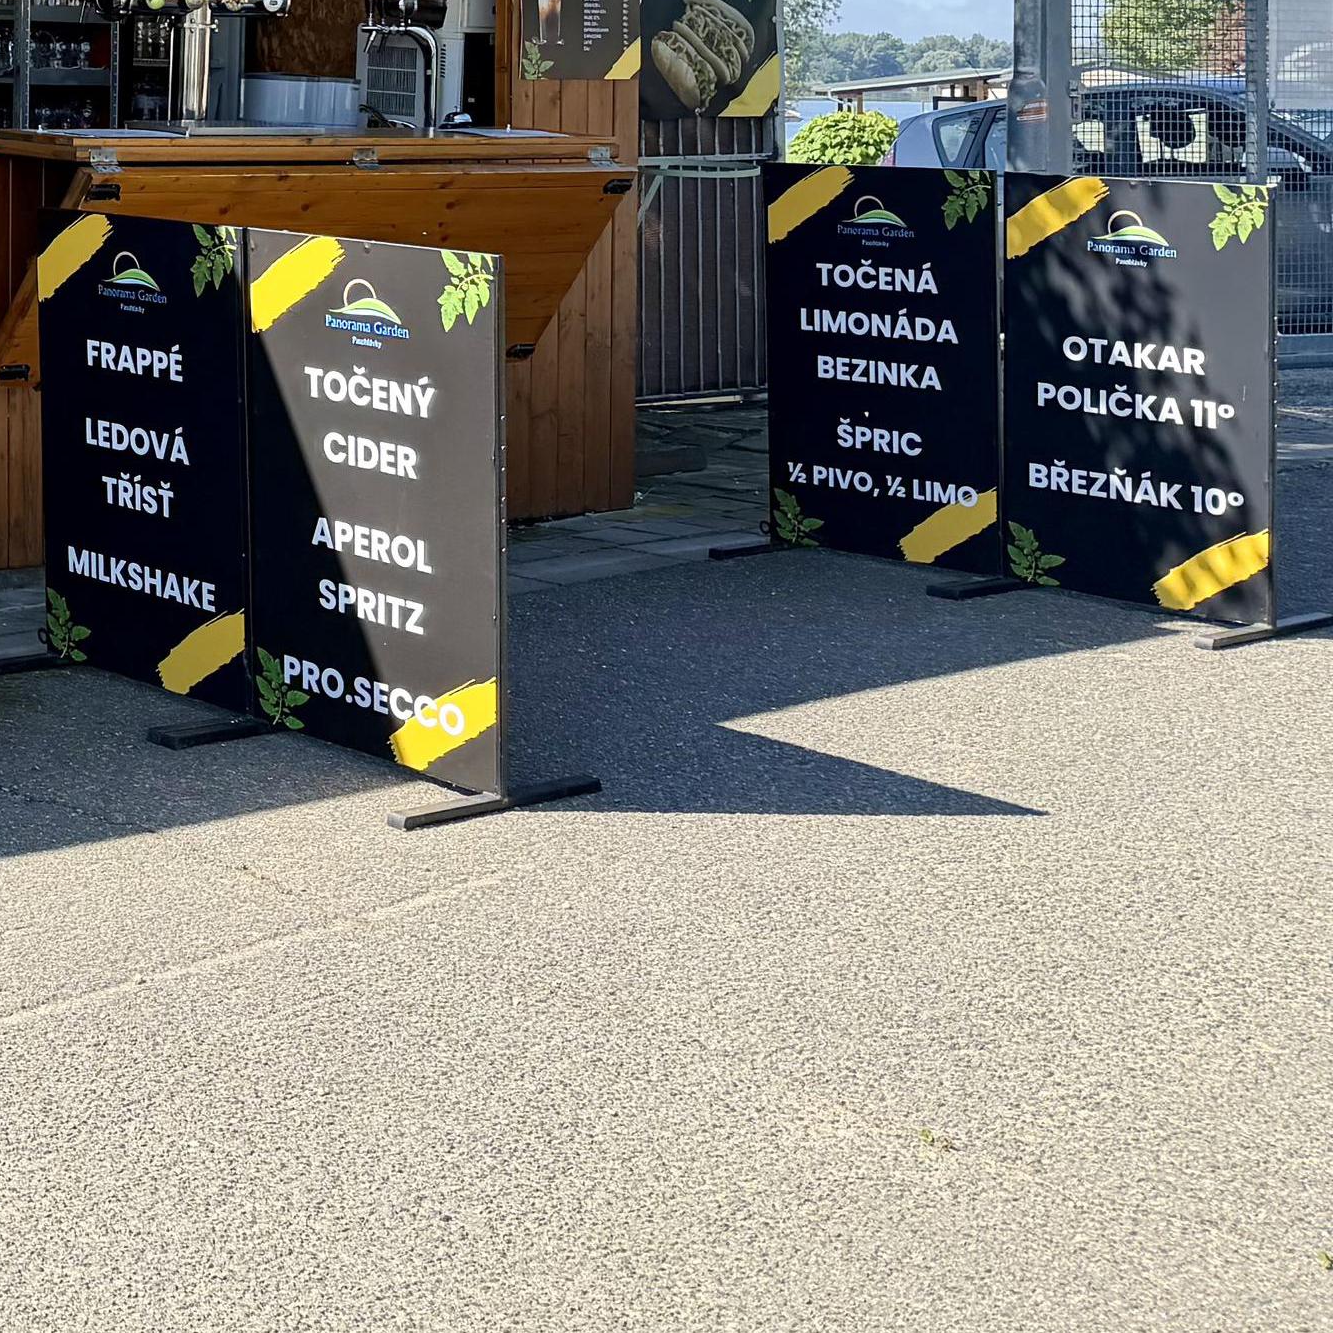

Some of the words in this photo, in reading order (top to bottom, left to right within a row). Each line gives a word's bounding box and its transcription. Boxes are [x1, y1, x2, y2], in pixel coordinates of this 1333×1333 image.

[837, 224, 879, 236] Panorama
[882, 227, 915, 238] Garden
[1087, 240, 1136, 255] Panorama
[1139, 245, 1177, 259] Garden
[98, 284, 135, 299] Panorama
[138, 289, 167, 304] Garden
[816, 258, 938, 295] TOČENÁ
[325, 314, 371, 333] Panorama
[374, 321, 409, 339] Garden
[800, 308, 959, 345] LIMONÁDA
[87, 339, 183, 383] FRAPPÉ
[817, 355, 942, 391] BEZINKA
[1063, 336, 1206, 376] OTAKAR
[304, 365, 436, 418] TOČENÝ
[1037, 382, 1184, 425] POLIČKA
[85, 417, 190, 466] LEDOVÁ
[323, 432, 418, 480] CIDER
[837, 417, 923, 456] ŠPRIC
[813, 465, 880, 497] PIVO,
[913, 478, 978, 508] LIMO
[1028, 459, 1183, 510] BŘEZŇÁK
[311, 517, 434, 574] APEROL
[67, 545, 216, 613] MILKSHAKE
[319, 578, 425, 636] SPRITZ
